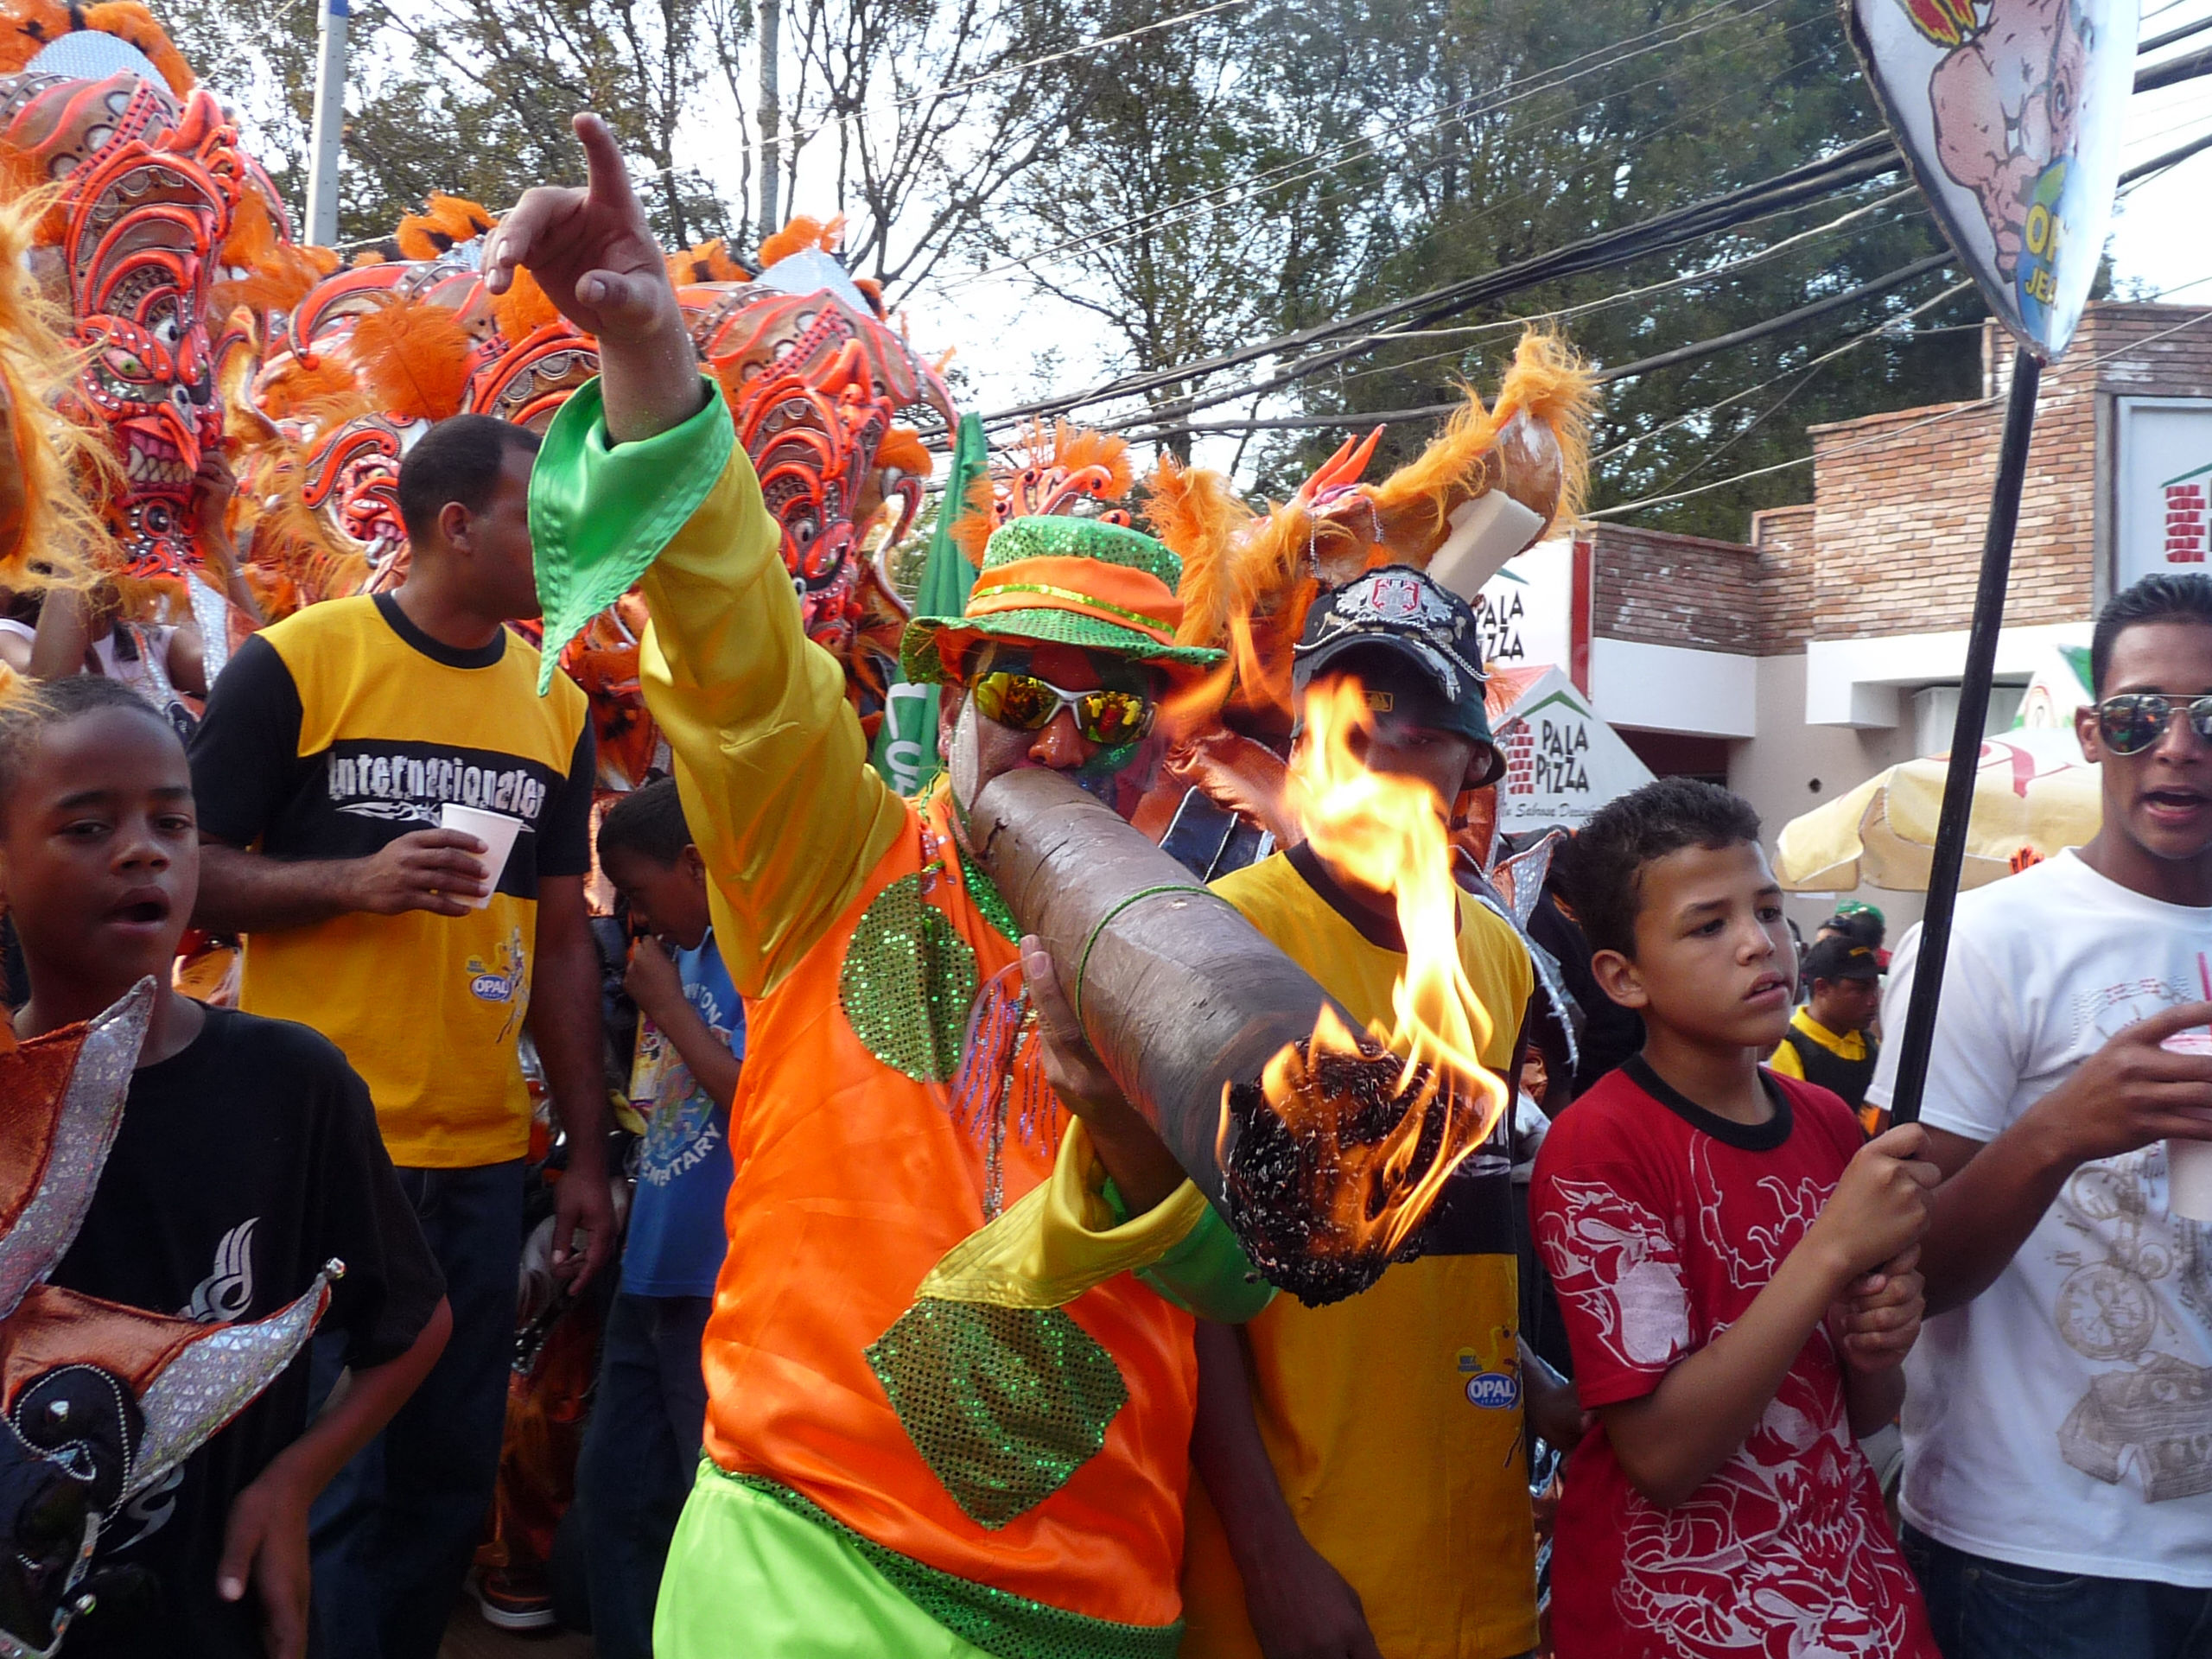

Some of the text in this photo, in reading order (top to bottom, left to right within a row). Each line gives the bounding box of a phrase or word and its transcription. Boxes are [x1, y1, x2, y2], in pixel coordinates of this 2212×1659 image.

[1541, 718, 1589, 766] PALA
[475, 979, 509, 994] OPAL
[1470, 1380, 1515, 1398] OPAL
